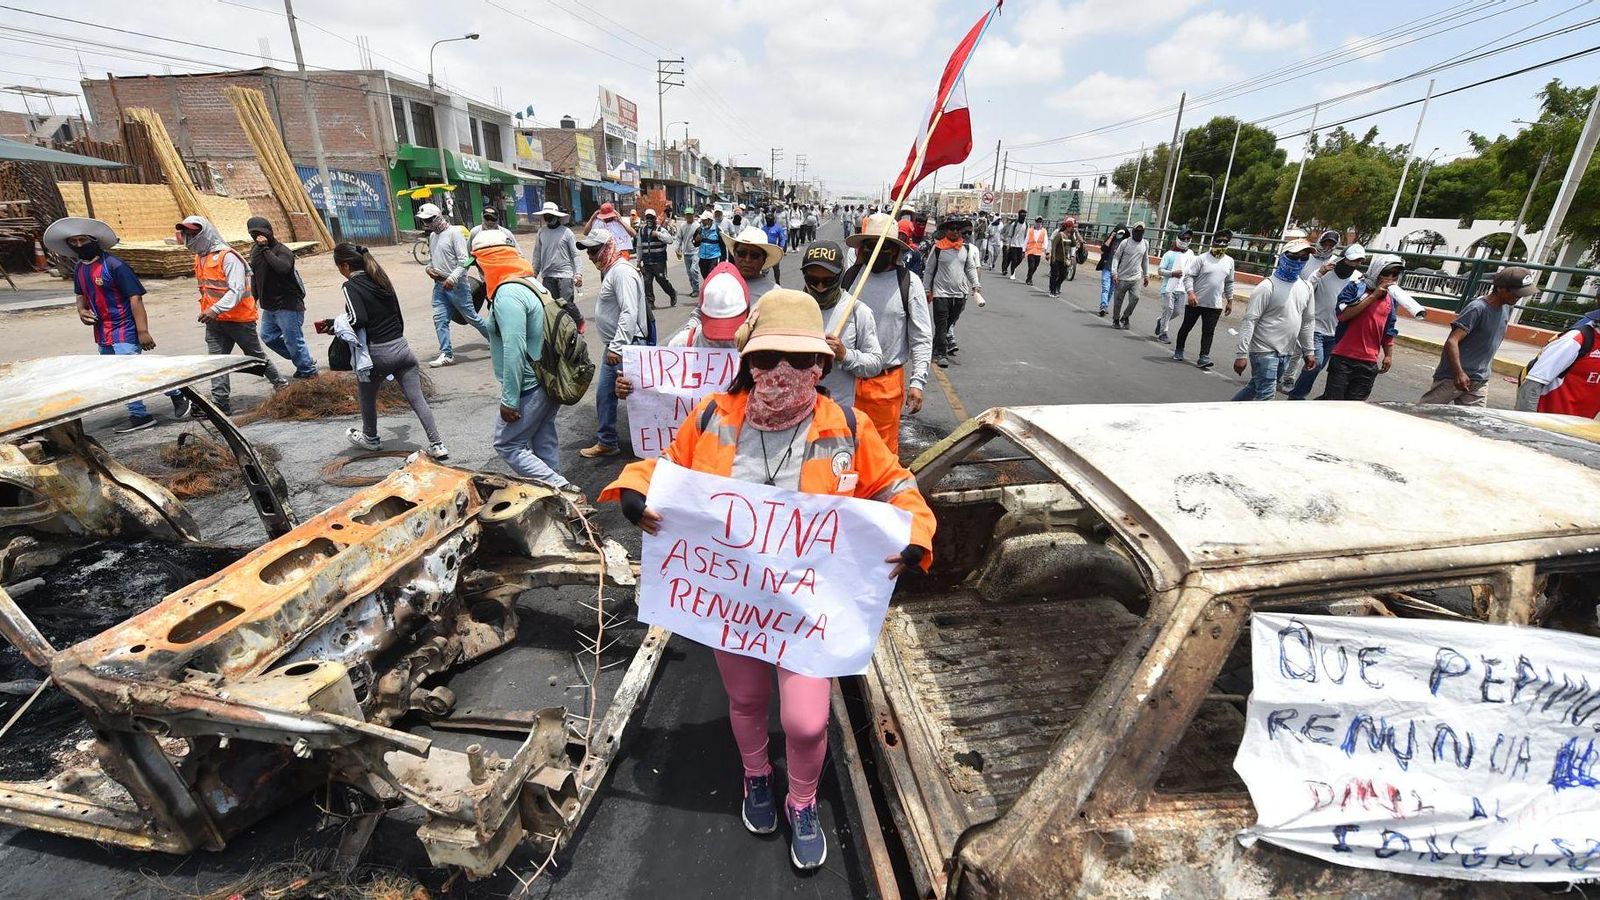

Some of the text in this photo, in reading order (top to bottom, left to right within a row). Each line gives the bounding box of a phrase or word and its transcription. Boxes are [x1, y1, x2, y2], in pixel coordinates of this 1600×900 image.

[808, 248, 836, 261] PERÚ
[710, 492, 839, 558] DINA
[660, 538, 816, 596] ASESINA
[669, 577, 828, 641] RENUNCIA
[1278, 617, 1387, 689] QUE
